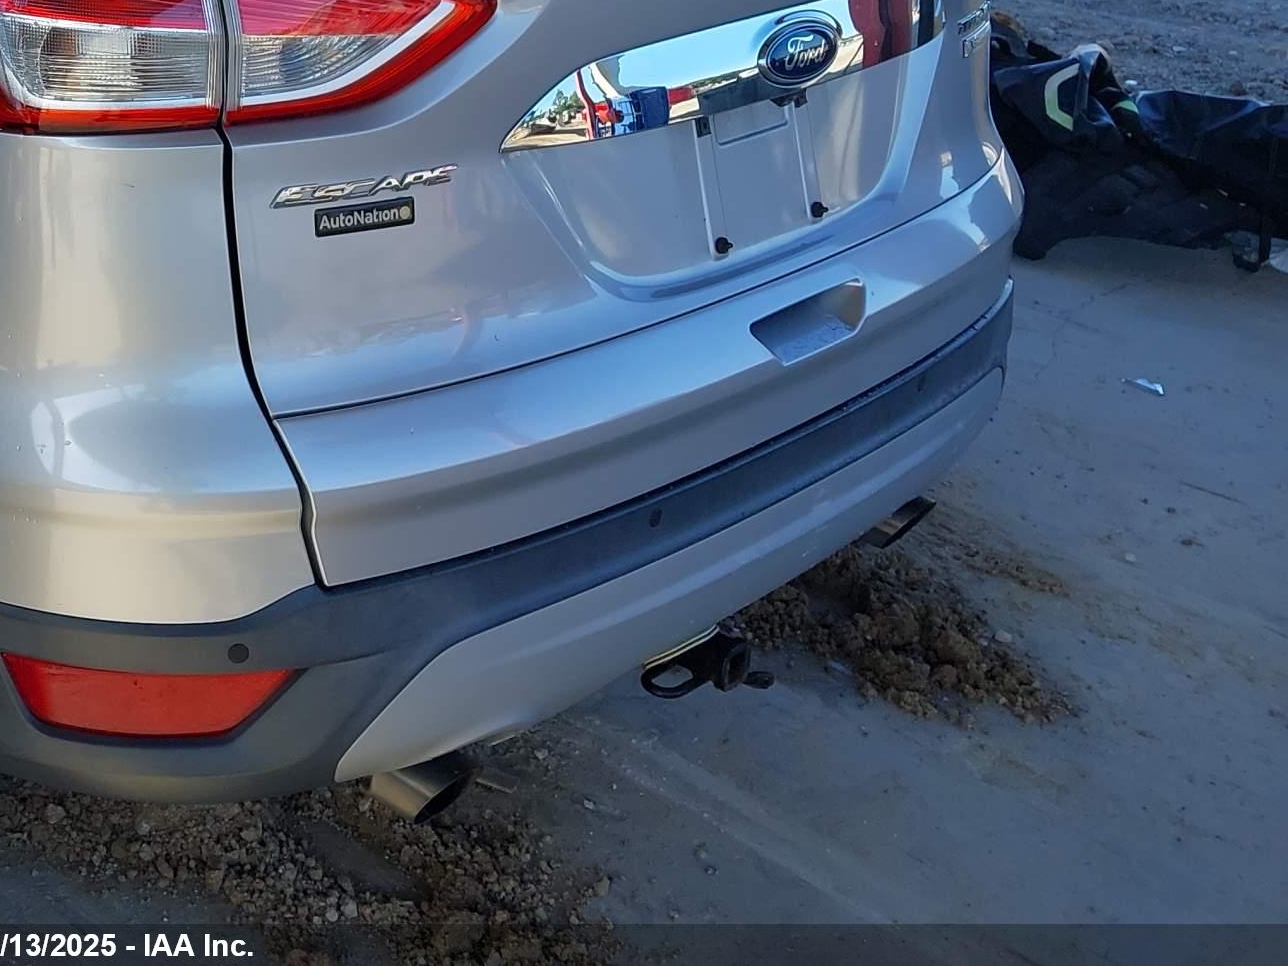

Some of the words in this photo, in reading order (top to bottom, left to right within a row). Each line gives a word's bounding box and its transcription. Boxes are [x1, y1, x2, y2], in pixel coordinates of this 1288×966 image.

[784, 34, 829, 71] Ford
[270, 163, 458, 209] ESCAPE
[319, 207, 399, 230] AutoNation
